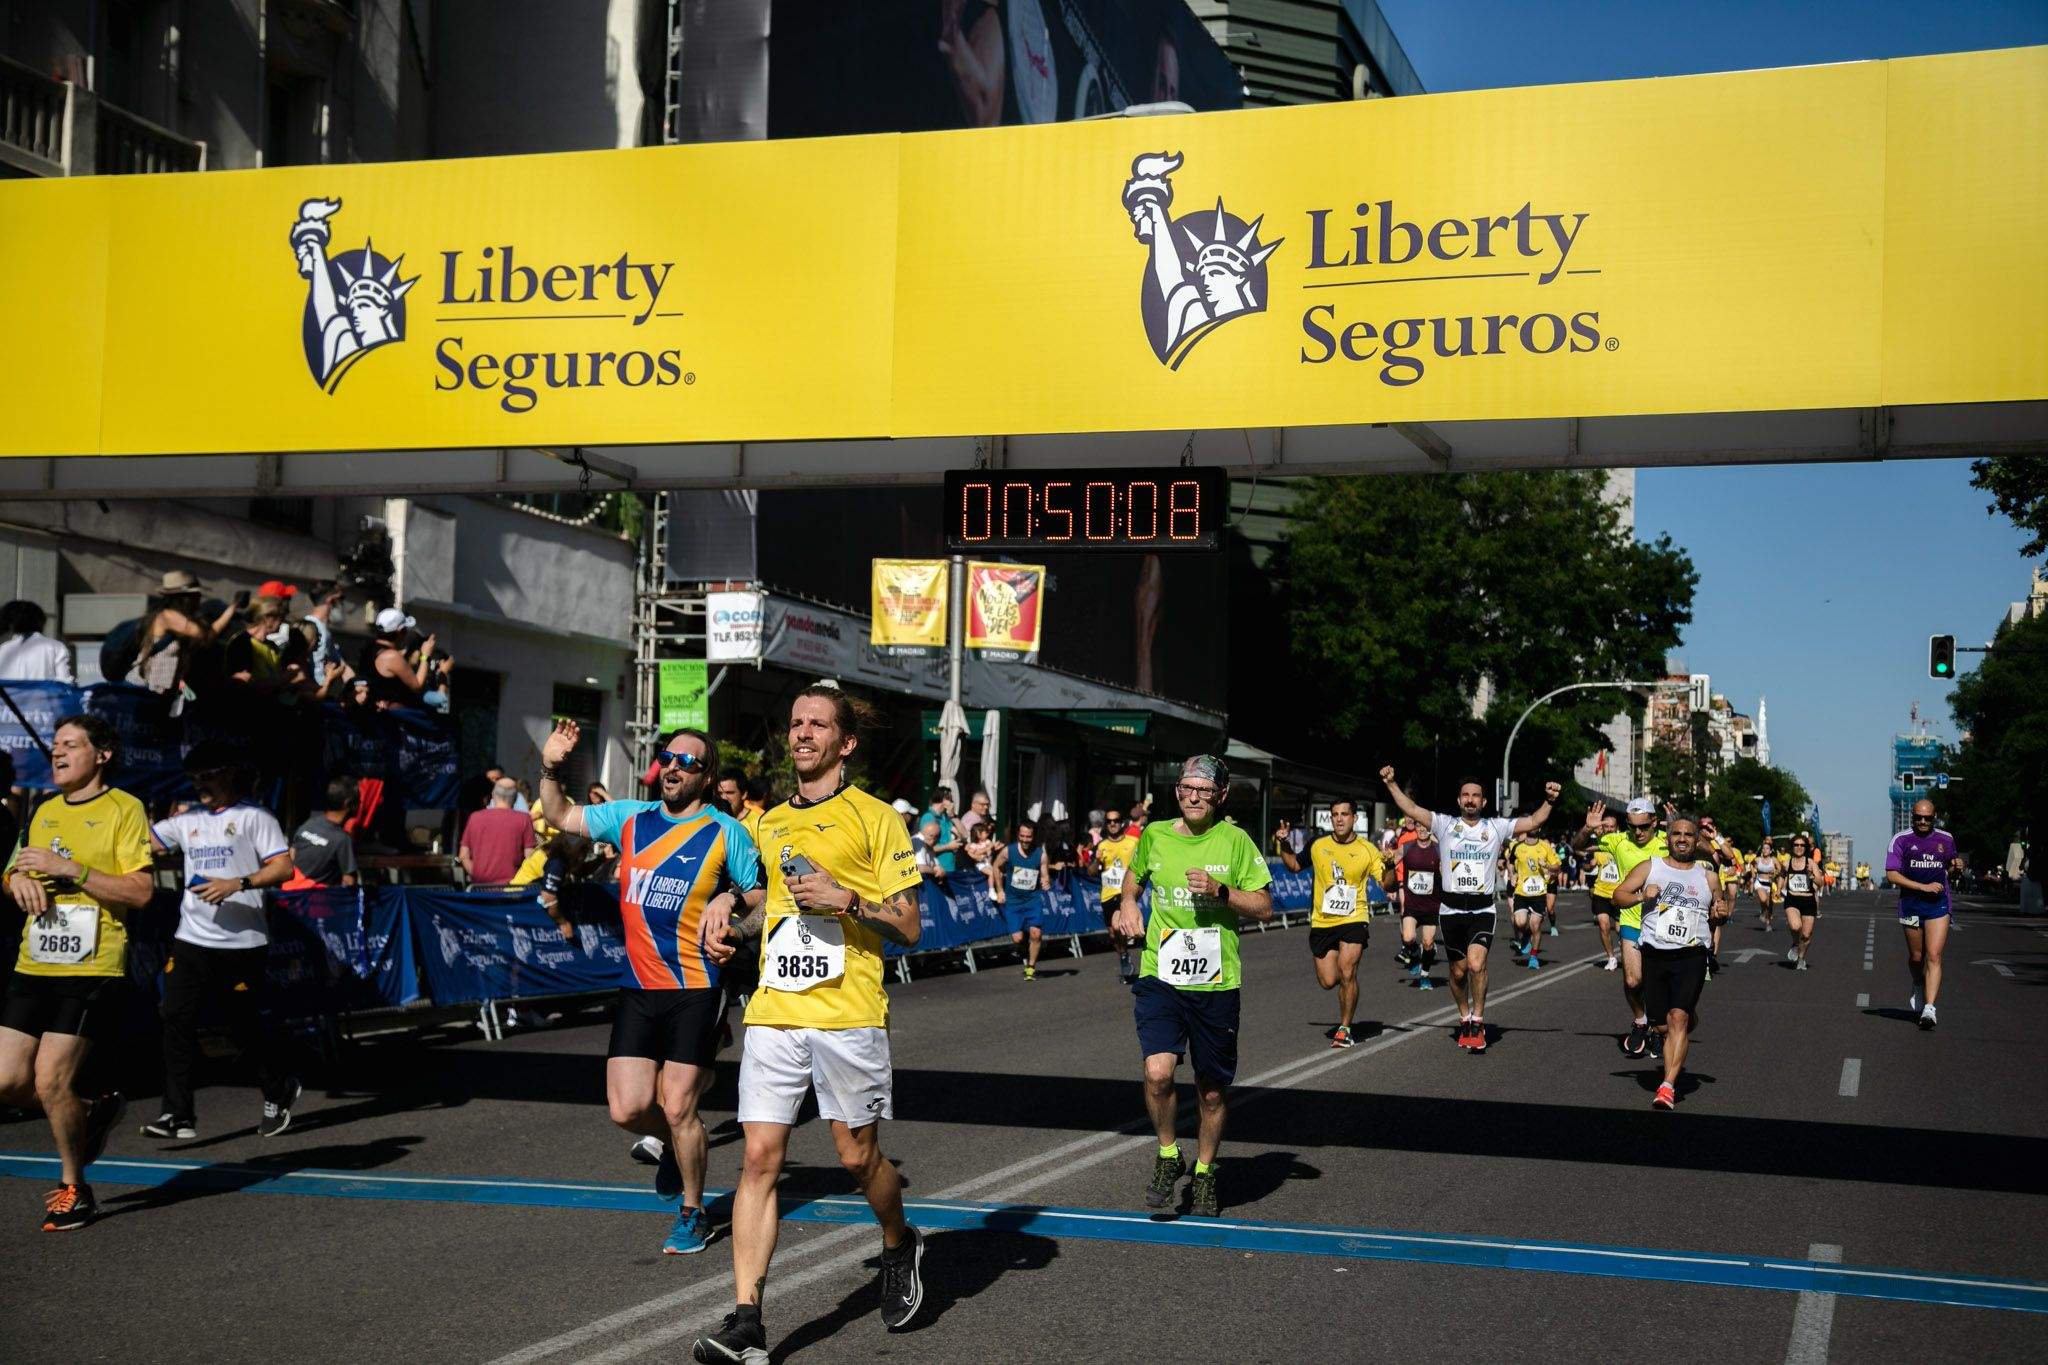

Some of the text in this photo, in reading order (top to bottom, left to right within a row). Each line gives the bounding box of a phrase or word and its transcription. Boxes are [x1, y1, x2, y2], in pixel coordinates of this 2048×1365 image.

[1304, 200, 1590, 286] Liberty
[437, 245, 675, 326] Liberty
[896, 647, 926, 656] MADRID
[990, 652, 1019, 660] MADRID
[188, 845, 234, 860] Emirates
[1463, 843, 1477, 852] Fly
[1449, 850, 1492, 860] Emirates
[1922, 853, 1934, 862] Fly
[1204, 864, 1230, 873] DKV
[1909, 860, 1944, 869] Emirates
[625, 867, 655, 905] XI
[651, 875, 690, 896] CARRERA
[1456, 876, 1478, 887] 1965
[645, 891, 685, 912] LIBERTY
[1329, 900, 1350, 911] 2227
[1667, 924, 1688, 938] 657
[38, 935, 82, 953] 2683
[777, 954, 829, 978] 3835
[1171, 957, 1208, 976] 2472
